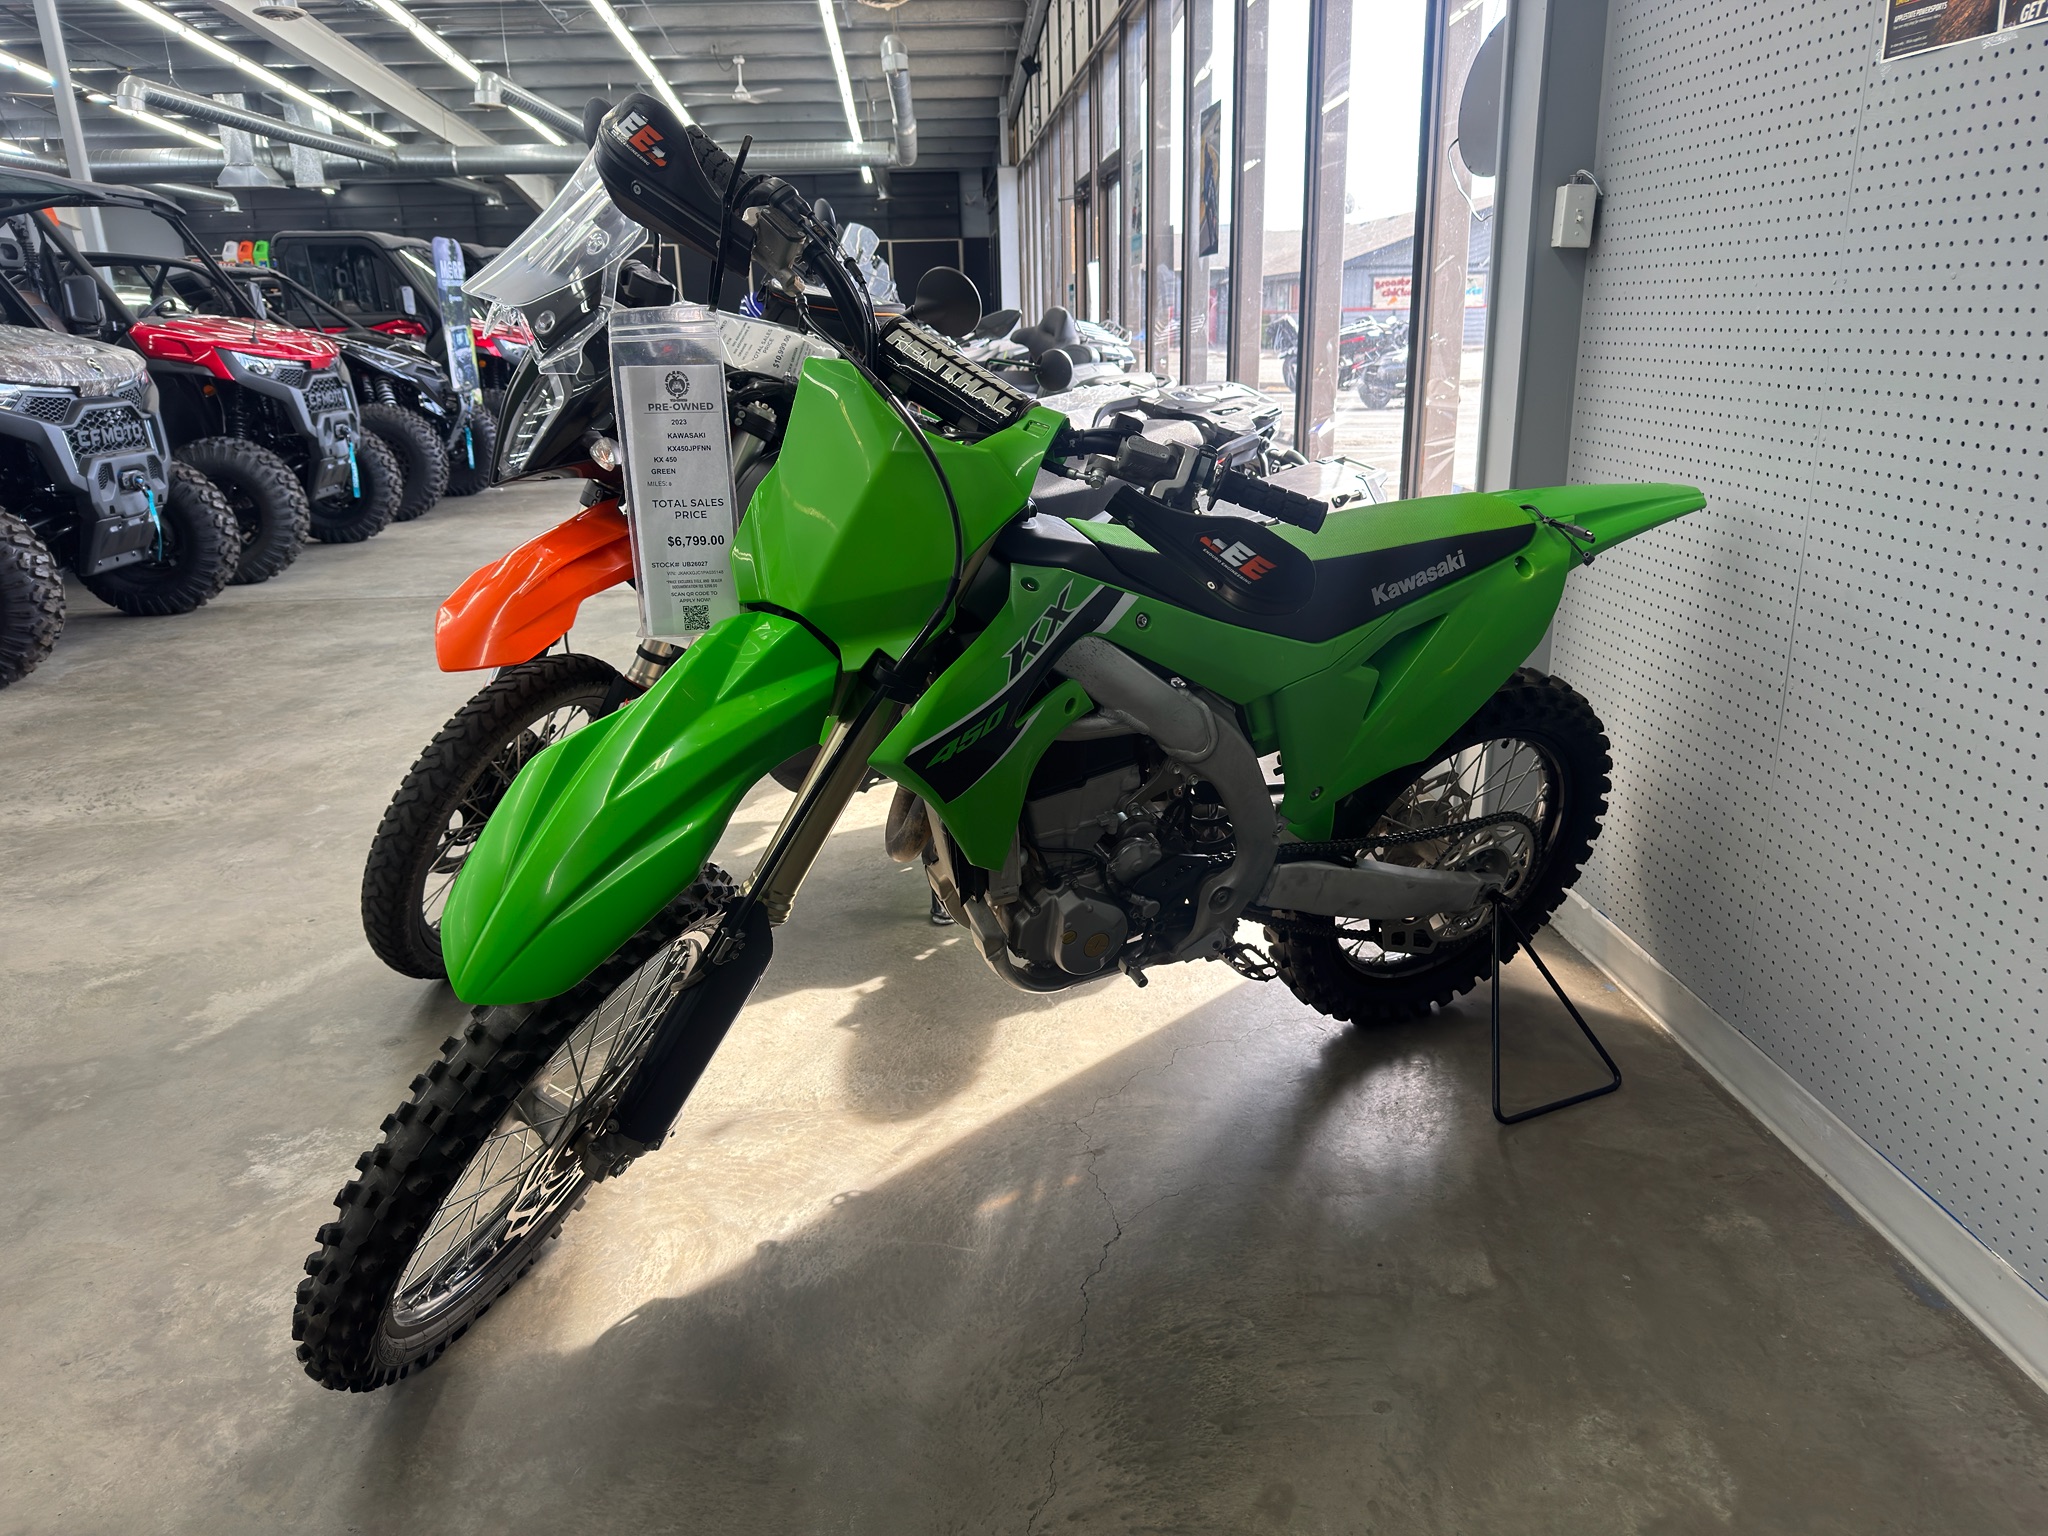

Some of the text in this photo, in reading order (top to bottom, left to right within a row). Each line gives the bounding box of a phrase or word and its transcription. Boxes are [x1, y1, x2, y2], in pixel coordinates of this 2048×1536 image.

[2019, 0, 2046, 23] GET
[761, 328, 773, 345] SALES
[762, 338, 775, 354] PRICE
[885, 328, 1014, 417] RENTHAL
[648, 402, 714, 412] PRE-OWNED
[77, 423, 143, 447] CFMOTO
[652, 498, 724, 508] TOTAL SALES
[675, 510, 708, 519] PRICE
[667, 535, 725, 548] $6,799.00
[1202, 548, 1252, 585] ENDURO ENGINEERING
[1370, 549, 1466, 606] Kawasaki
[924, 700, 1009, 770] 450
